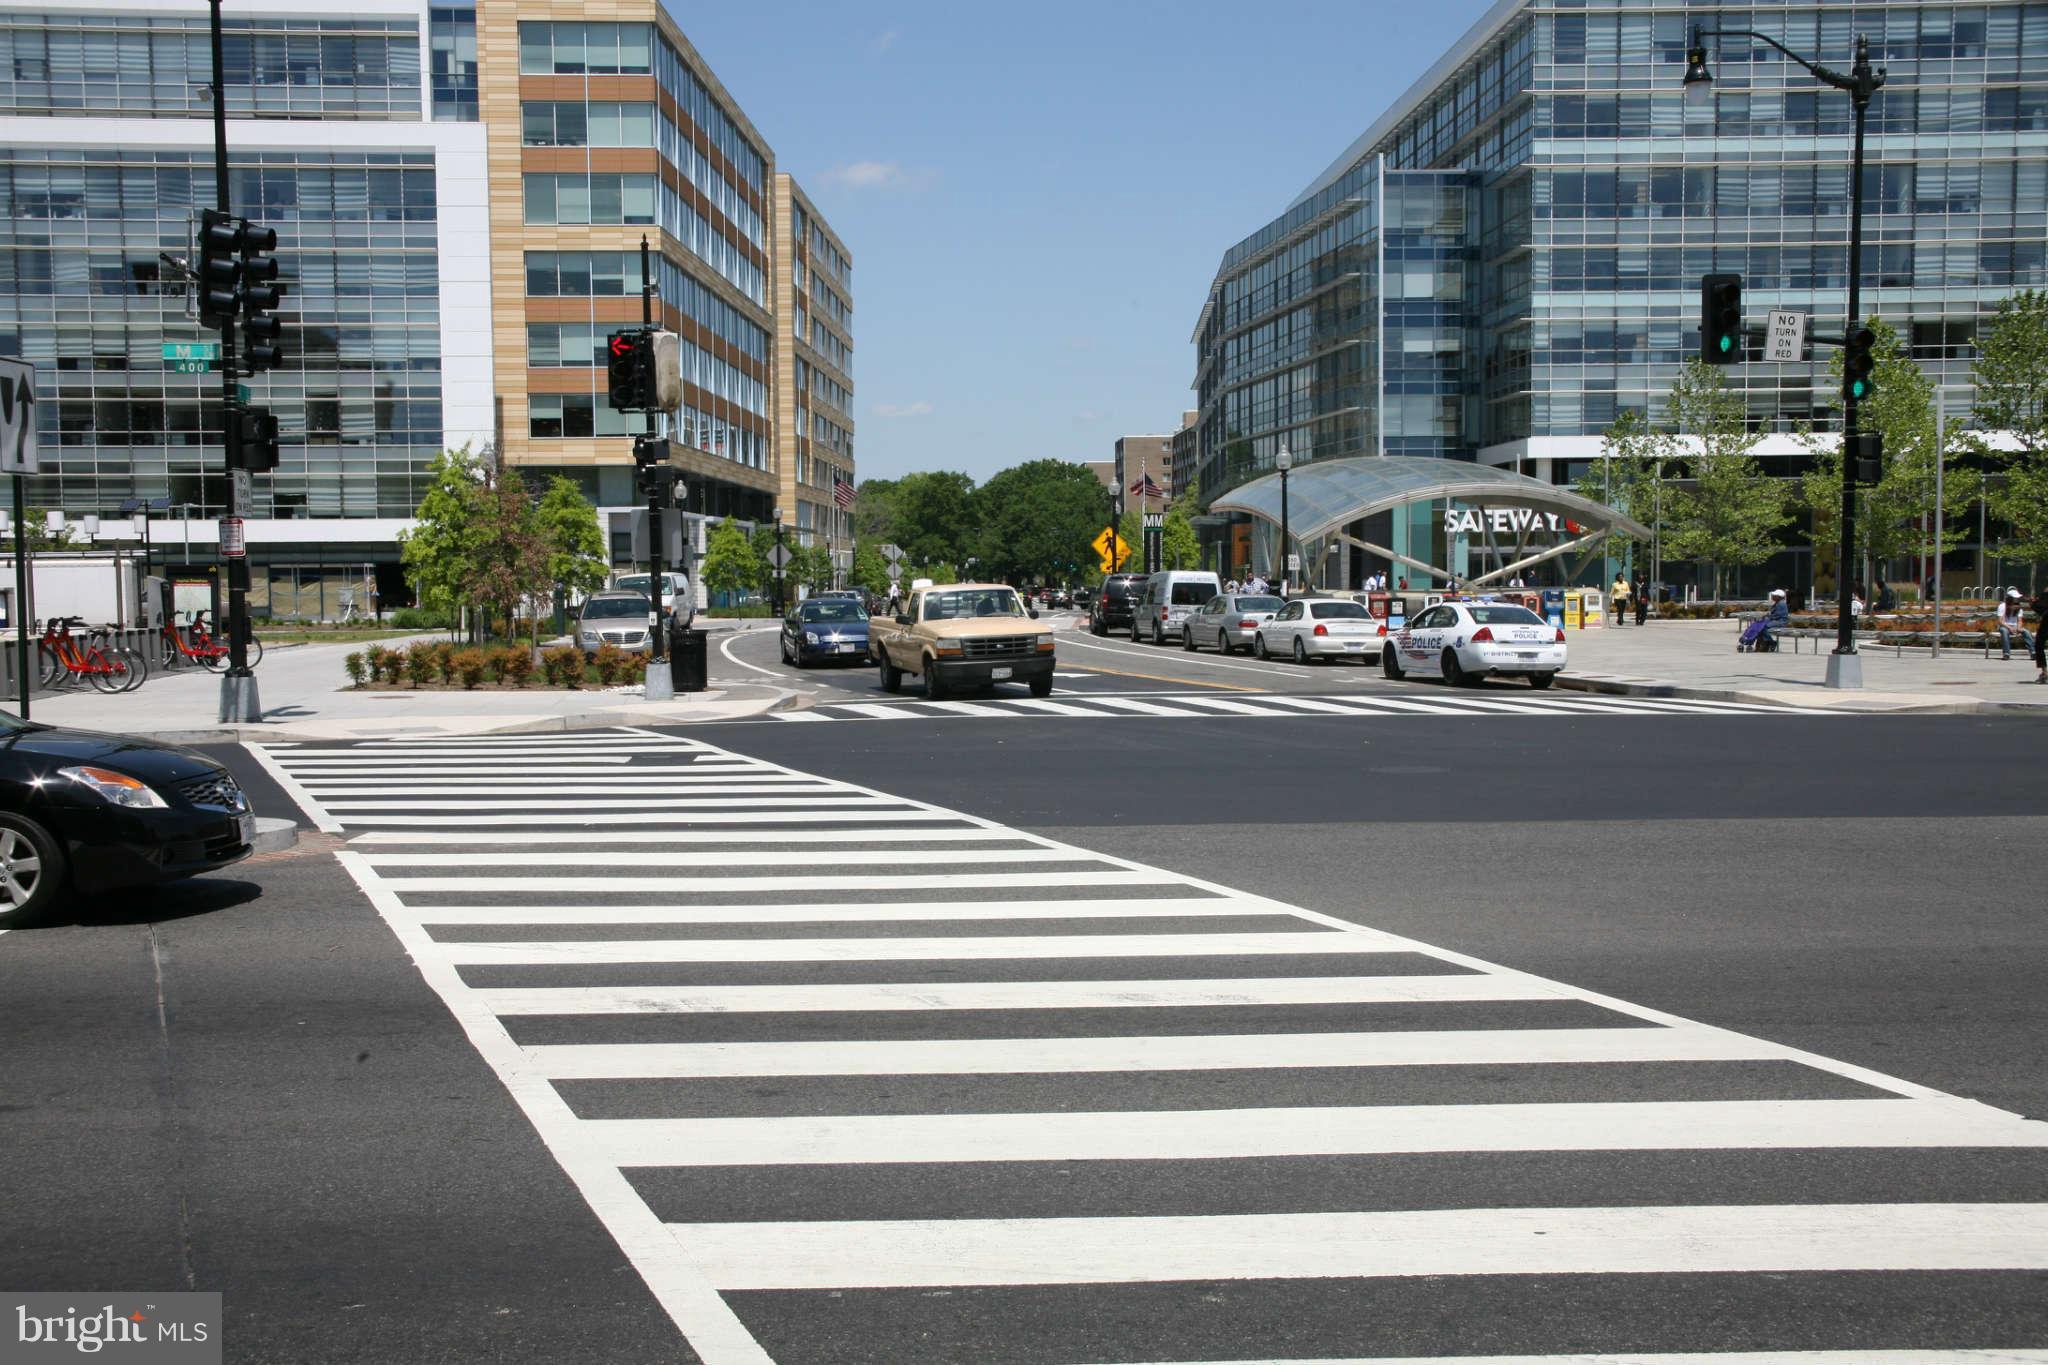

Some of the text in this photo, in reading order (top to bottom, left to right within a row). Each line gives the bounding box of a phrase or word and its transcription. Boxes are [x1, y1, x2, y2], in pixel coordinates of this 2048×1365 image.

[1778, 315, 1796, 326] NO
[1775, 327, 1797, 337] TURN
[1778, 338, 1791, 347] ON
[175, 344, 191, 359] M
[1775, 349, 1792, 358] RED
[179, 362, 204, 373] 400
[1443, 509, 1560, 533] SAFEWAY
[1411, 636, 1442, 650] POLICE
